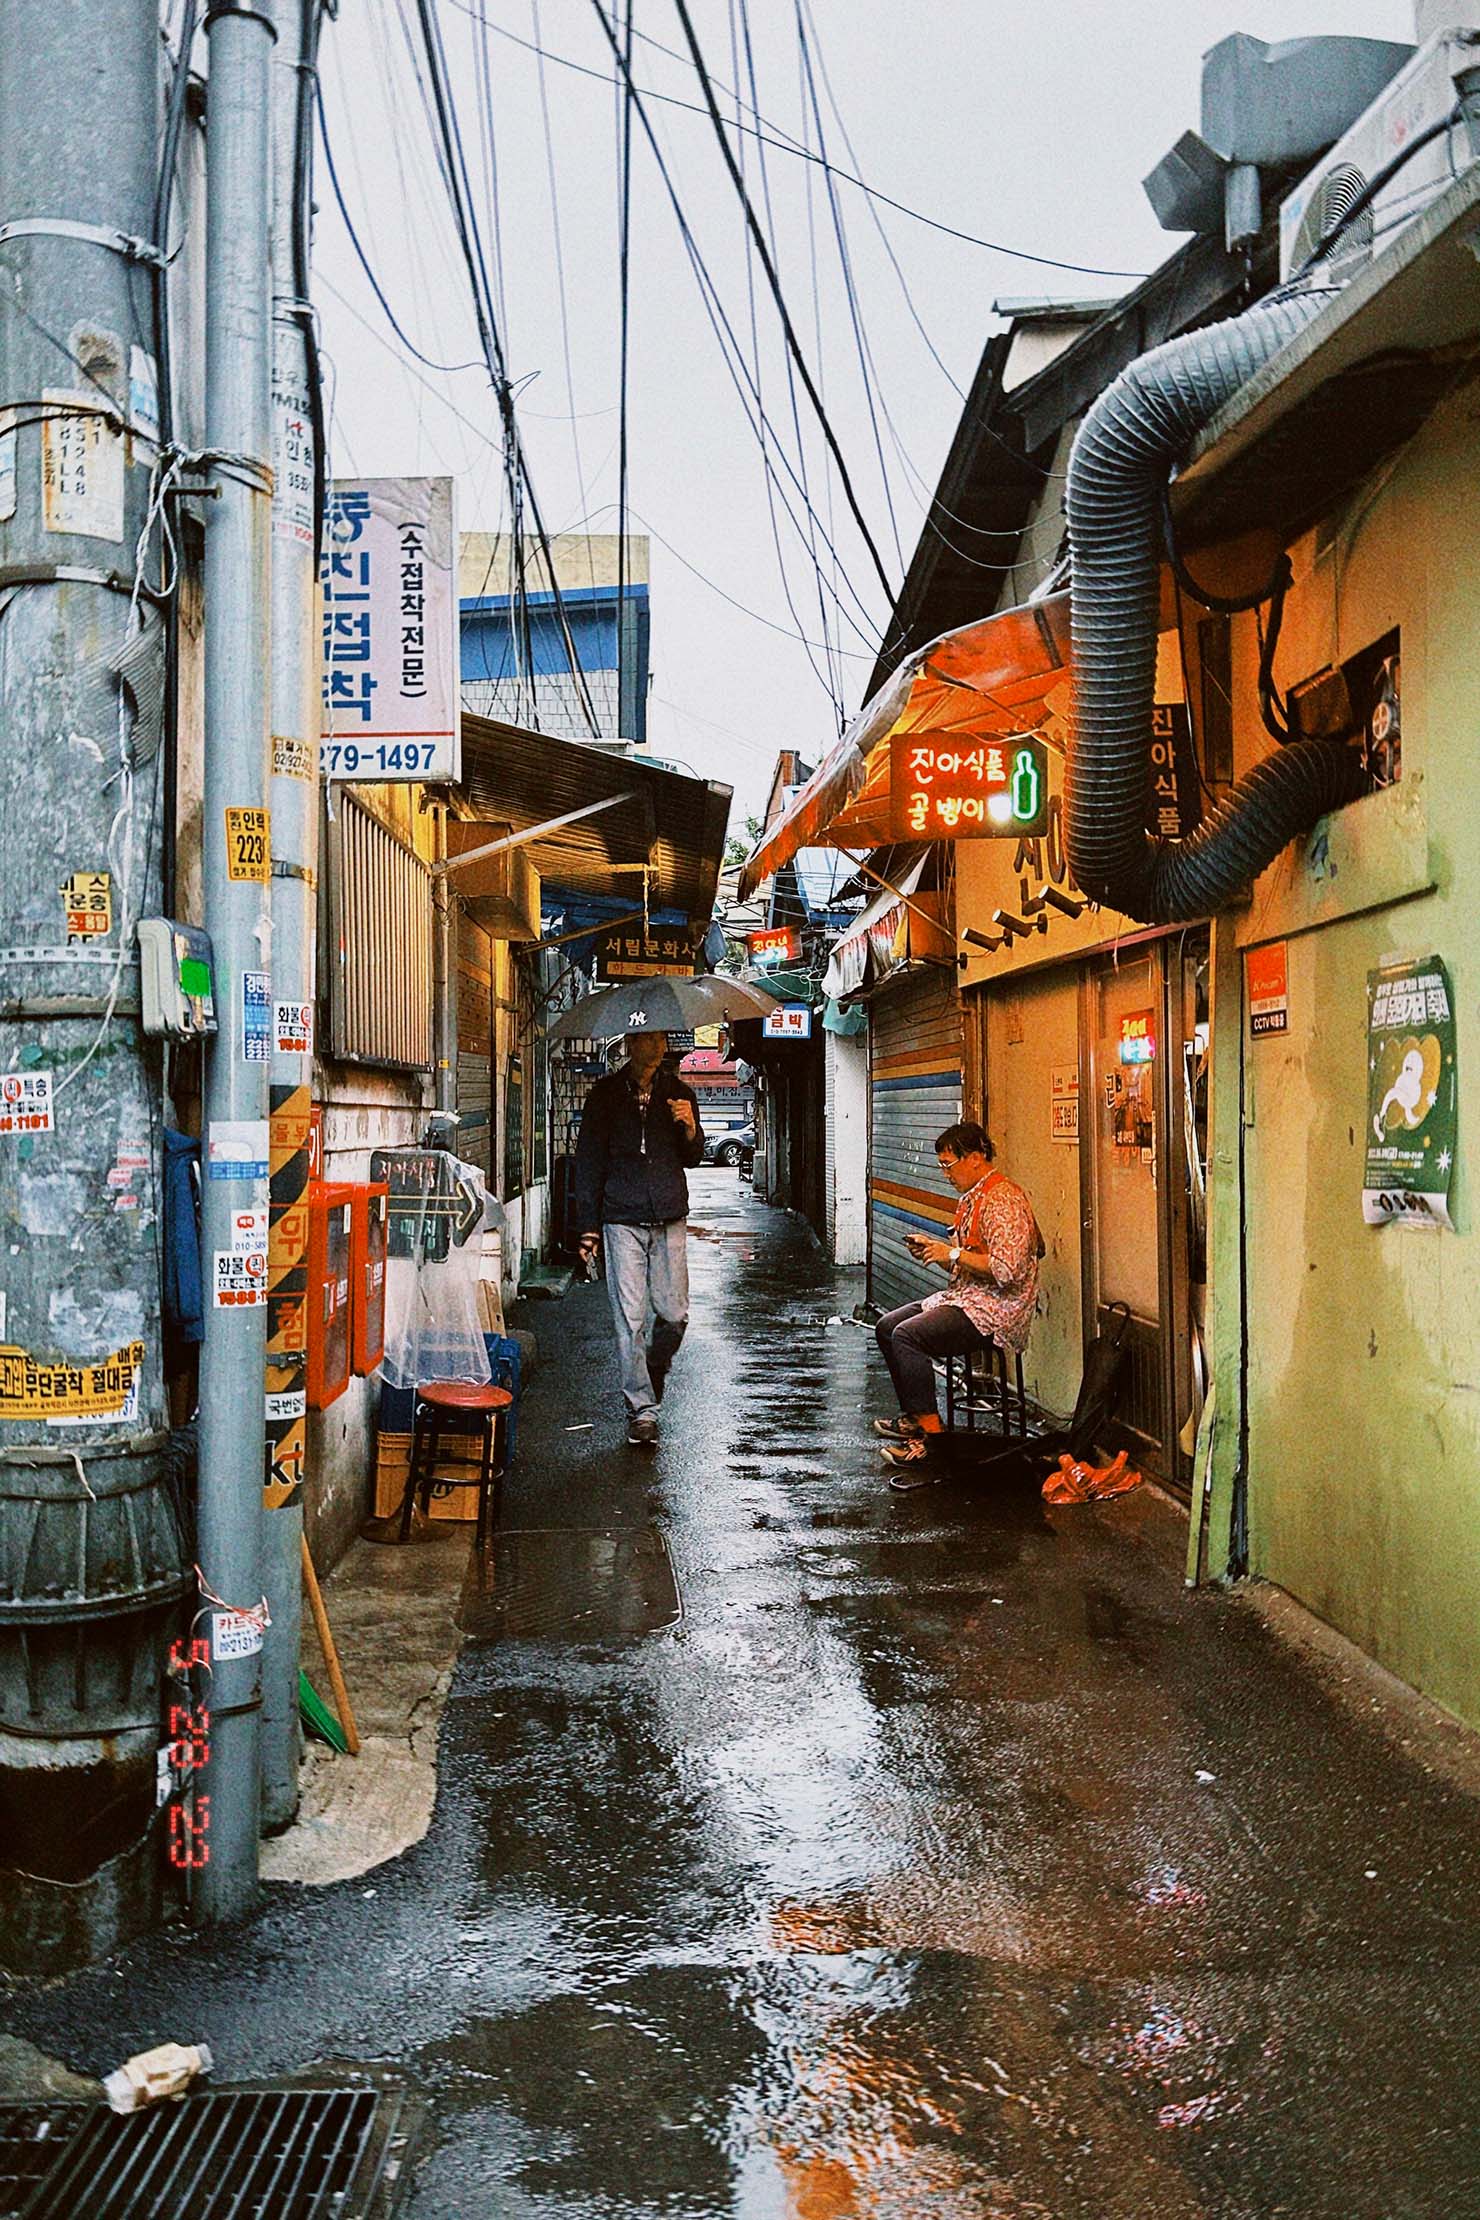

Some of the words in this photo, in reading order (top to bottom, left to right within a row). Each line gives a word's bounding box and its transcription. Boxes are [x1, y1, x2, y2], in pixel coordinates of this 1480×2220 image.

[397, 521, 427, 699] (수접착전문)
[909, 748, 1006, 784] 진아식품
[1151, 707, 1181, 834] 진아식품
[907, 791, 985, 832] 골뱅이
[628, 1010, 648, 1027] NY
[218, 1256, 244, 1276] 화물
[25, 1370, 83, 1399] 무단굴착
[91, 1364, 135, 1395] 절대금
[263, 1438, 304, 1488] kt
